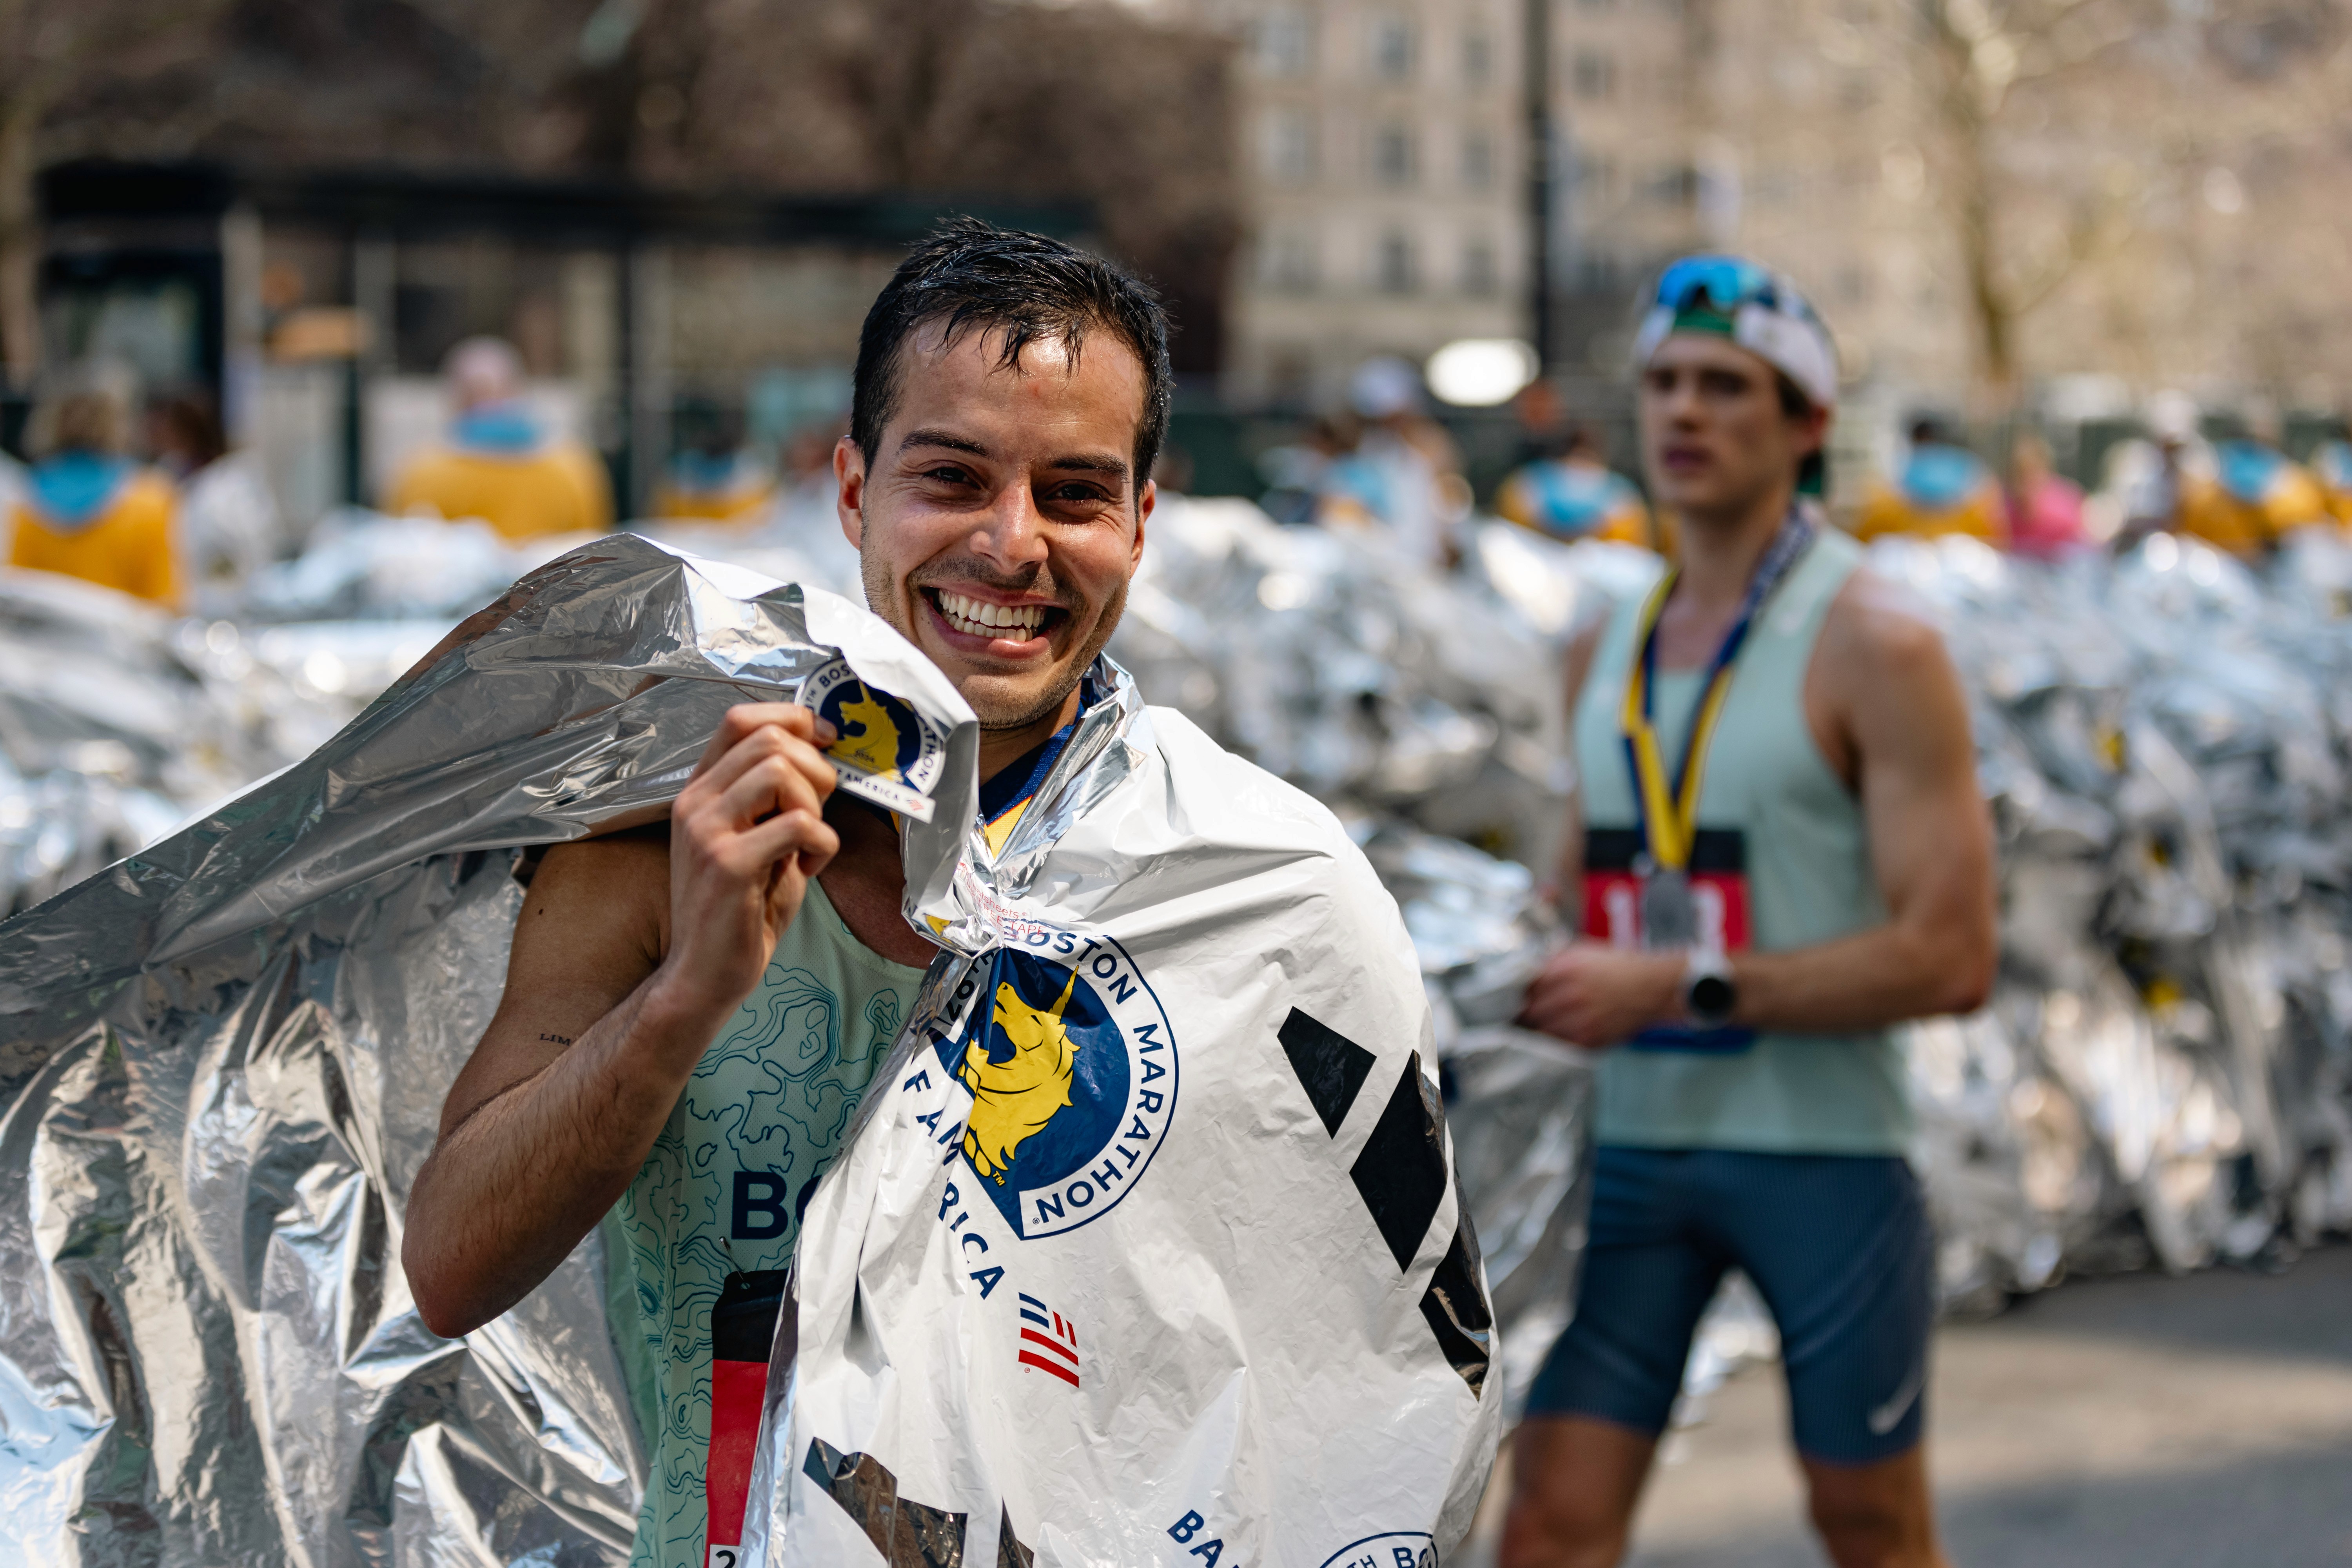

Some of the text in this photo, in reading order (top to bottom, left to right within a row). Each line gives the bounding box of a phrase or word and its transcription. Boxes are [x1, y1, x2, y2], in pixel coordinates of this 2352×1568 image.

[844, 773, 898, 800] AMERICA
[1009, 921, 1047, 936] TAPE
[1036, 1024, 1166, 1223] MARATHON
[915, 1105, 1005, 1300] AMRICA
[1167, 1509, 1240, 1568] BA
